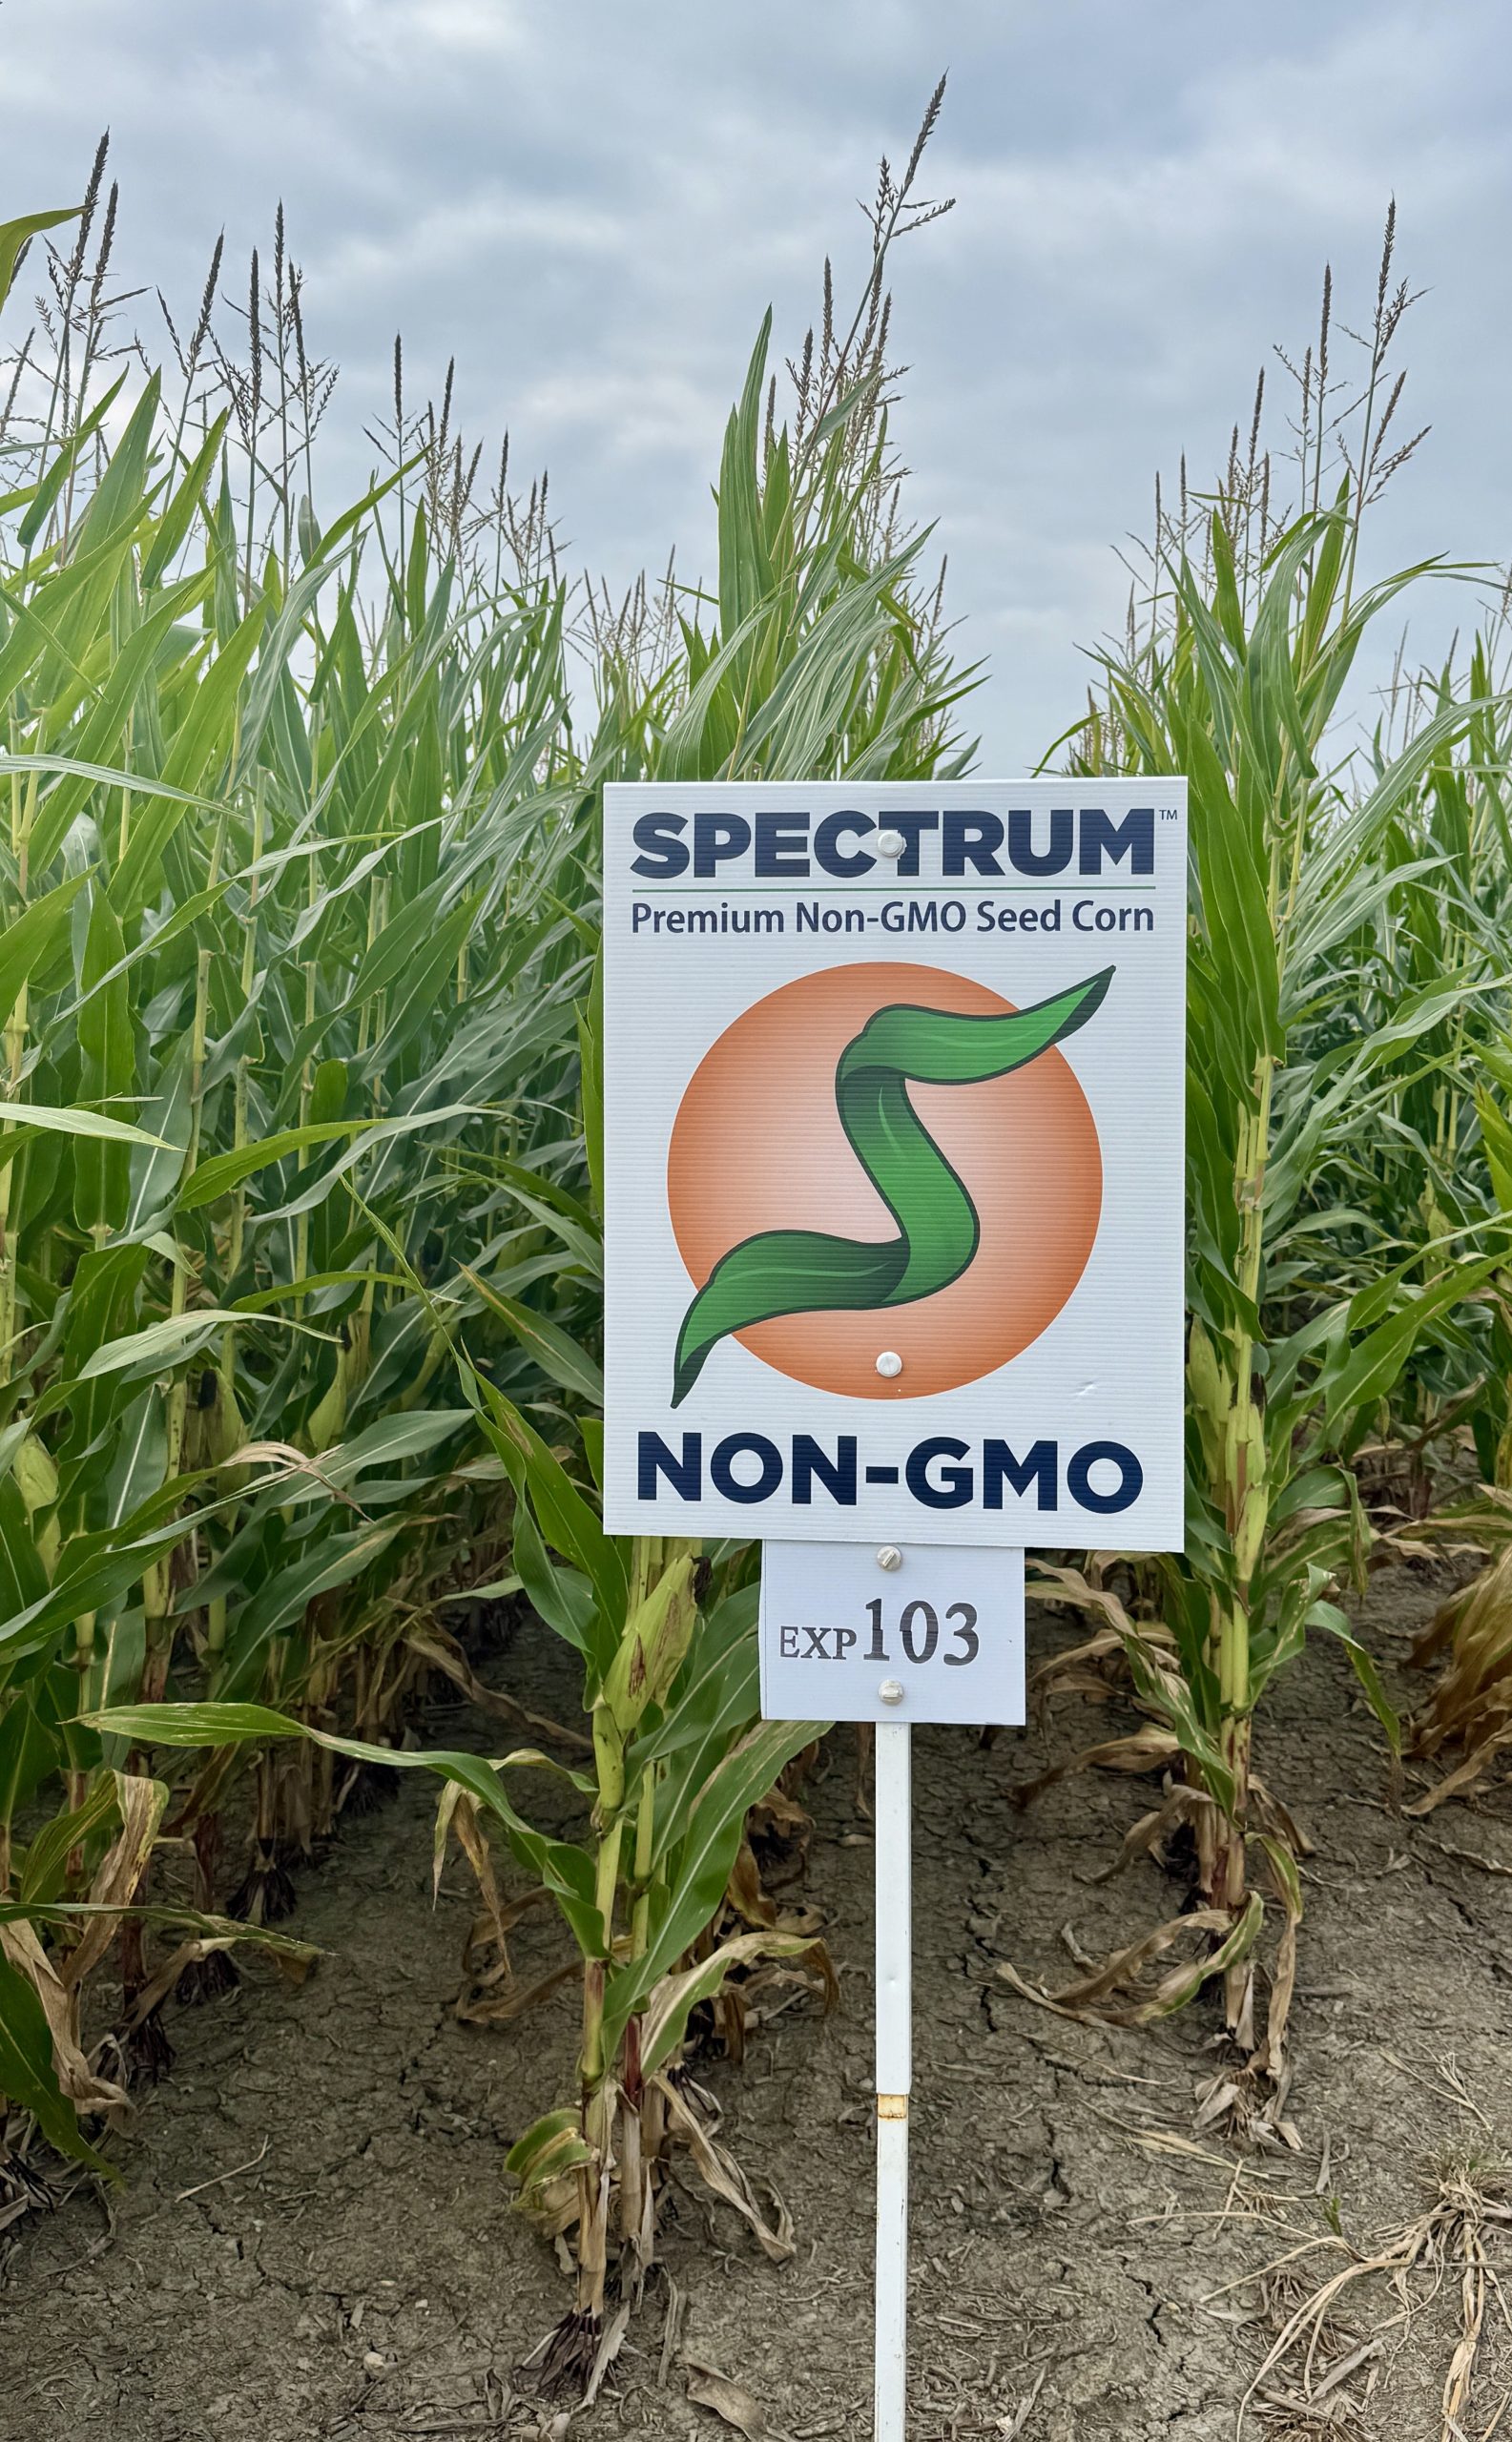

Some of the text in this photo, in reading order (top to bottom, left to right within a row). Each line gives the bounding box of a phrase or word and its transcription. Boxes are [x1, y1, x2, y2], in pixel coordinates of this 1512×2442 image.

[630, 808, 1155, 880] SPECTRUM
[632, 899, 1154, 934] Premium Non-GMO Seed Corn
[637, 1431, 1144, 1515] NON-GMO
